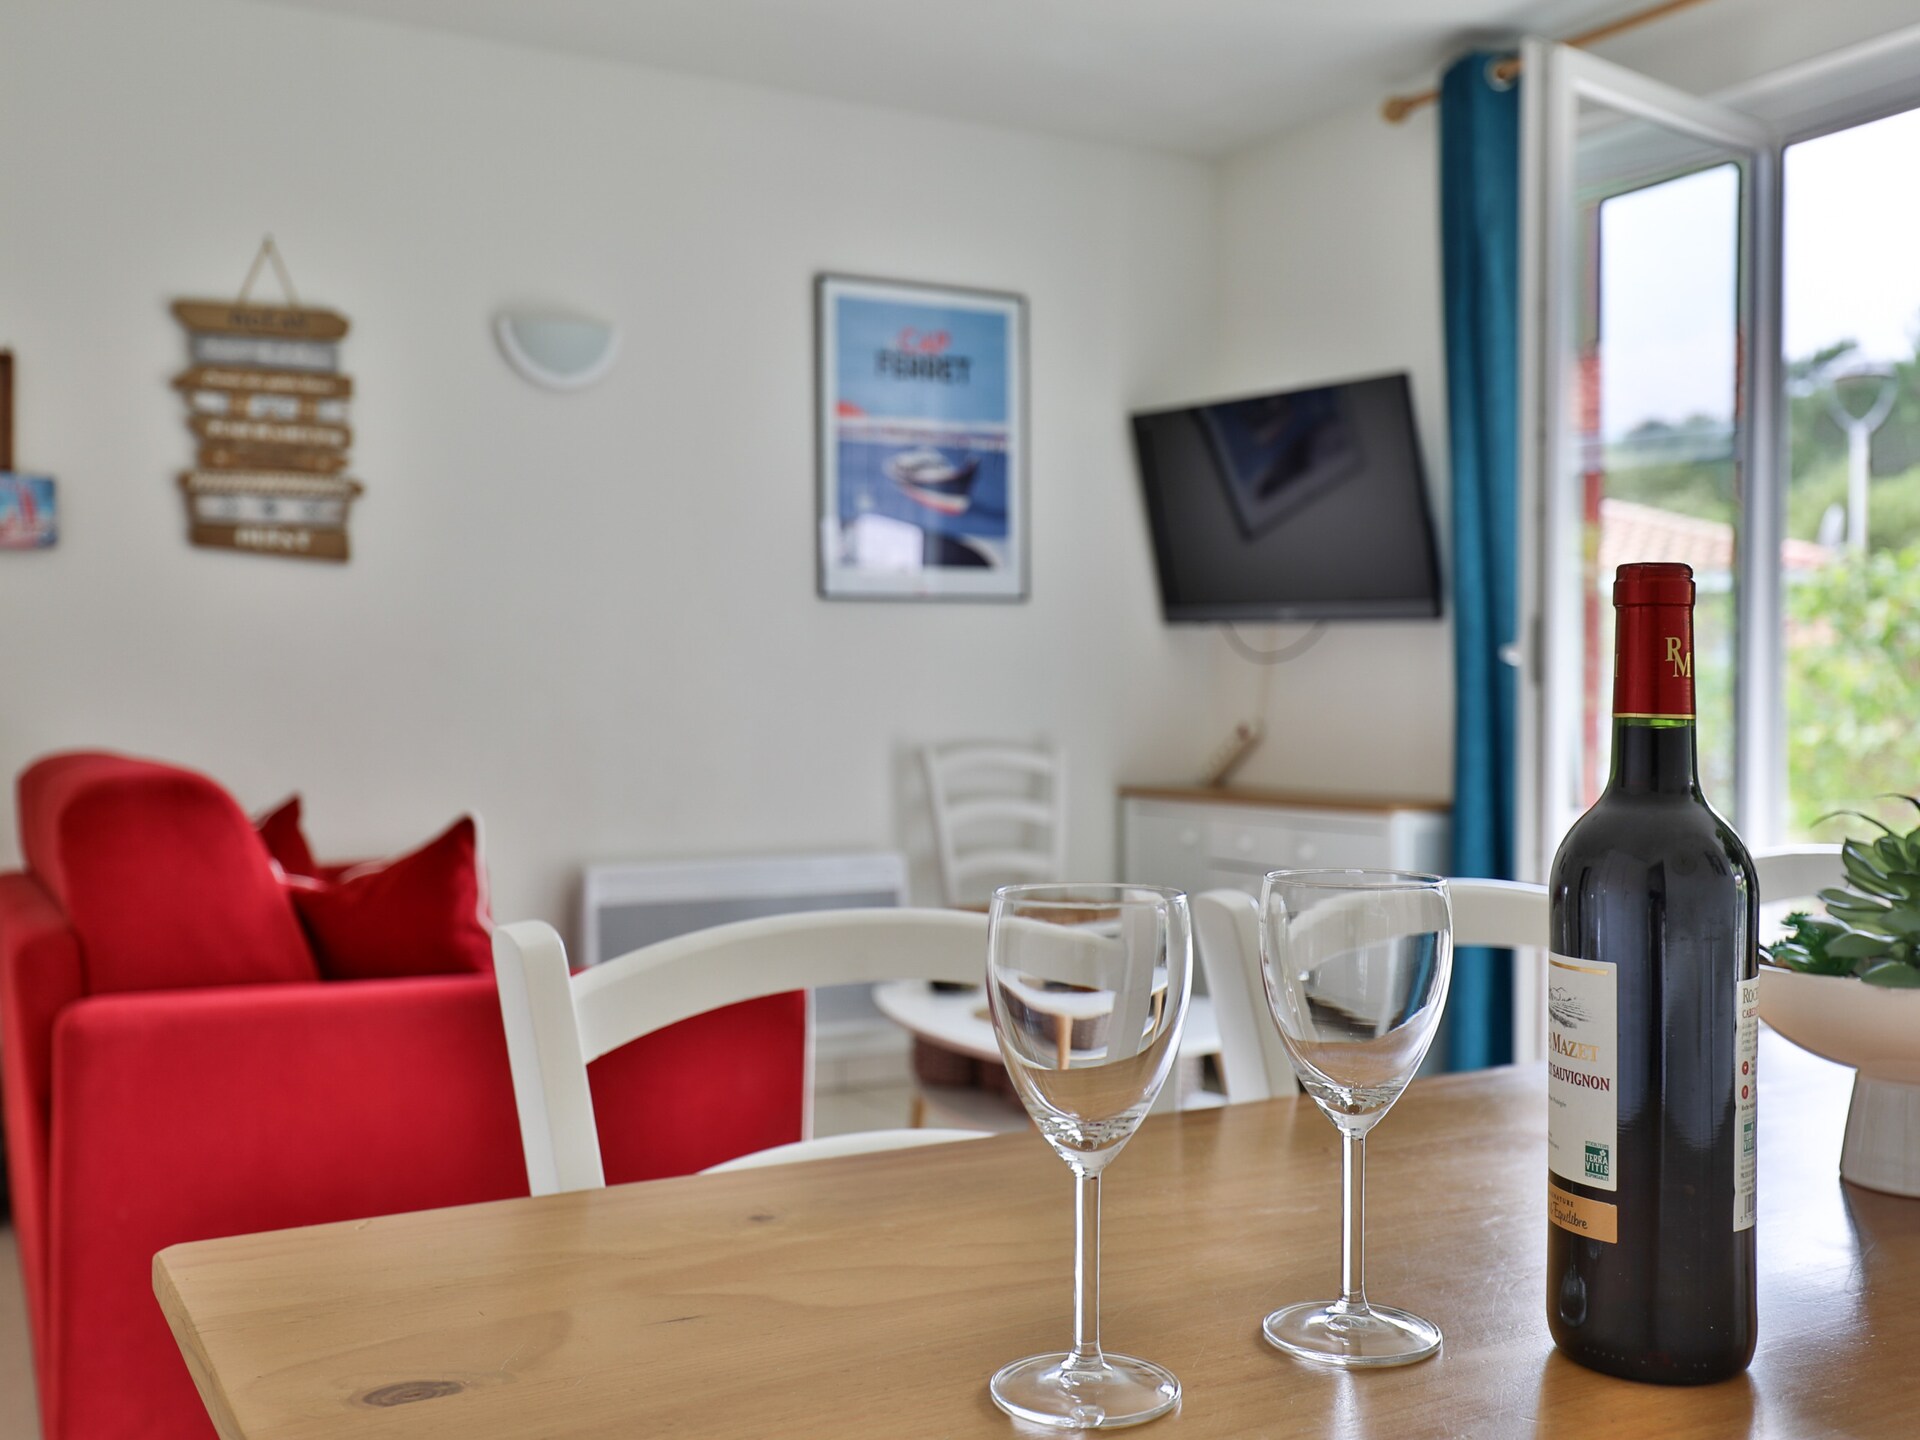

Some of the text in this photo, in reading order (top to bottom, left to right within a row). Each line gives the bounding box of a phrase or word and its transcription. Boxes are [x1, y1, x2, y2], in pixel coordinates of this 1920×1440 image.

[1553, 1031, 1600, 1062] MAZET
[1553, 1064, 1610, 1092] SAUVIGNON
[1585, 1152, 1608, 1166] TERRA
[1585, 1161, 1609, 1175] VITIS
